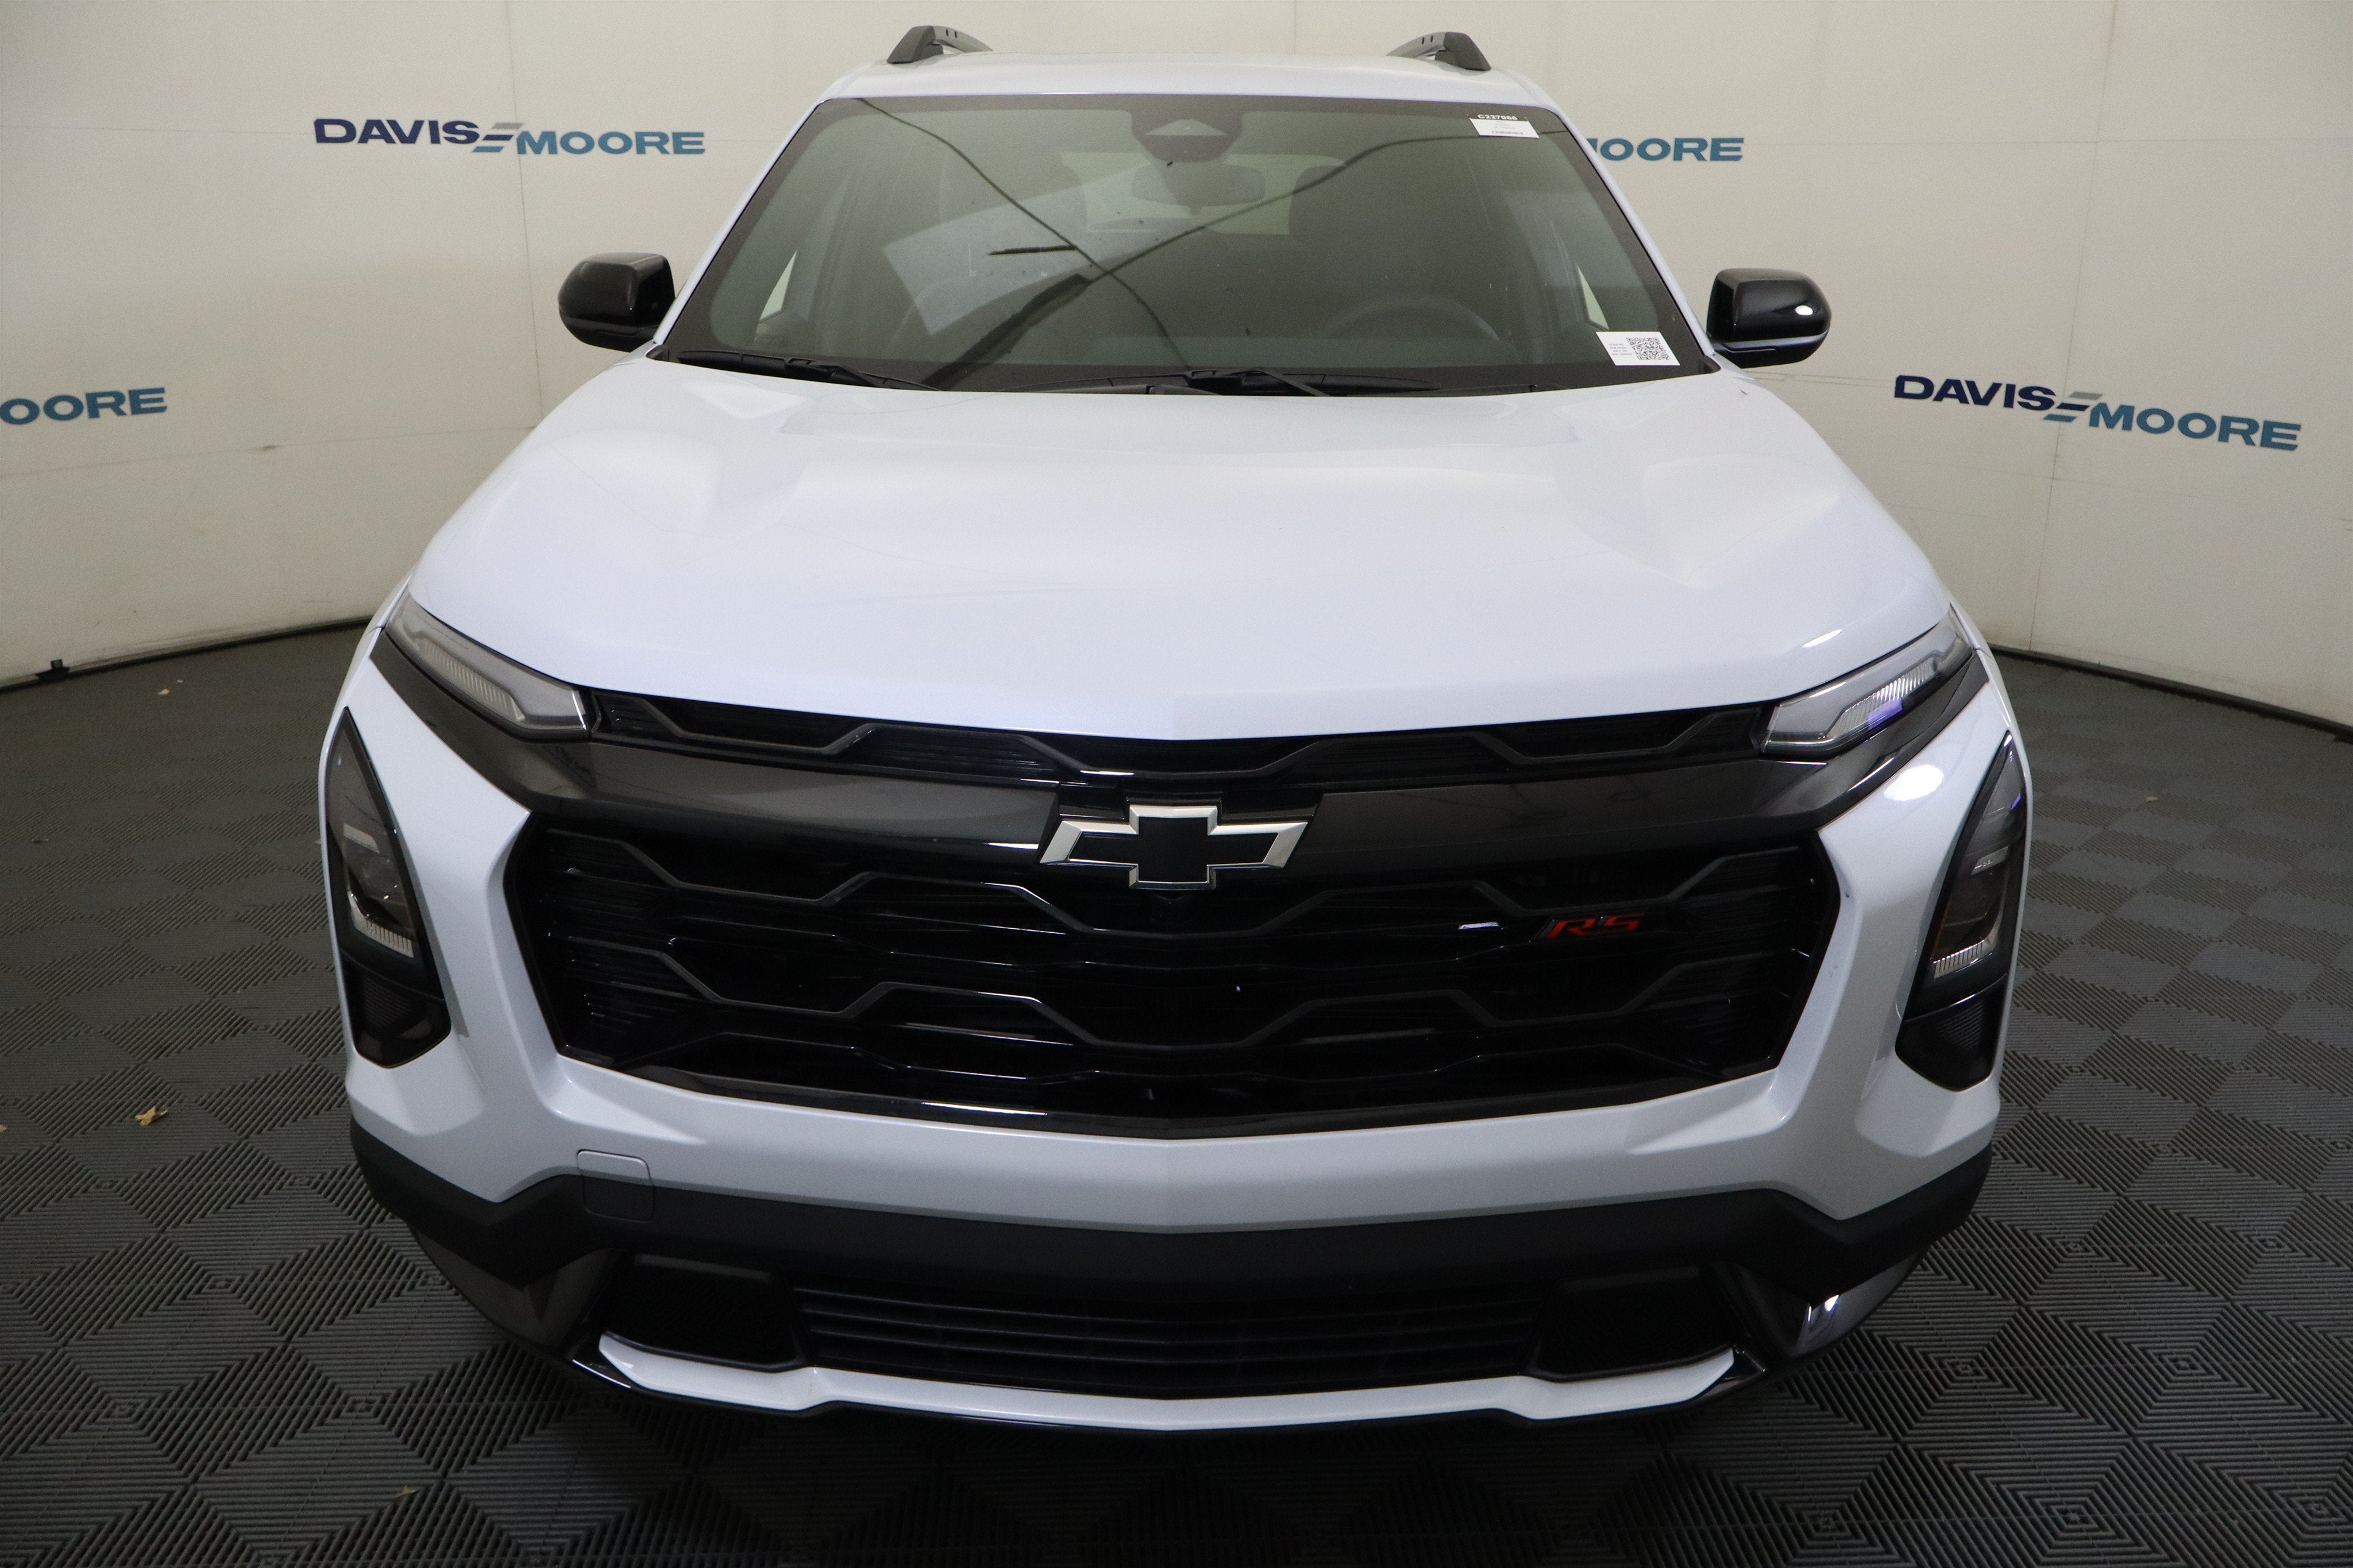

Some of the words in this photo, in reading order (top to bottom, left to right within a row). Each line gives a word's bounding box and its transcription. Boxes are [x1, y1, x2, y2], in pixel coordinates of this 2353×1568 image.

[313, 118, 480, 145] DAVIS
[516, 131, 705, 155] MOORE
[1893, 374, 2057, 412] DAVIS
[2089, 401, 2302, 452] MOORE
[1538, 913, 1644, 940] RS
